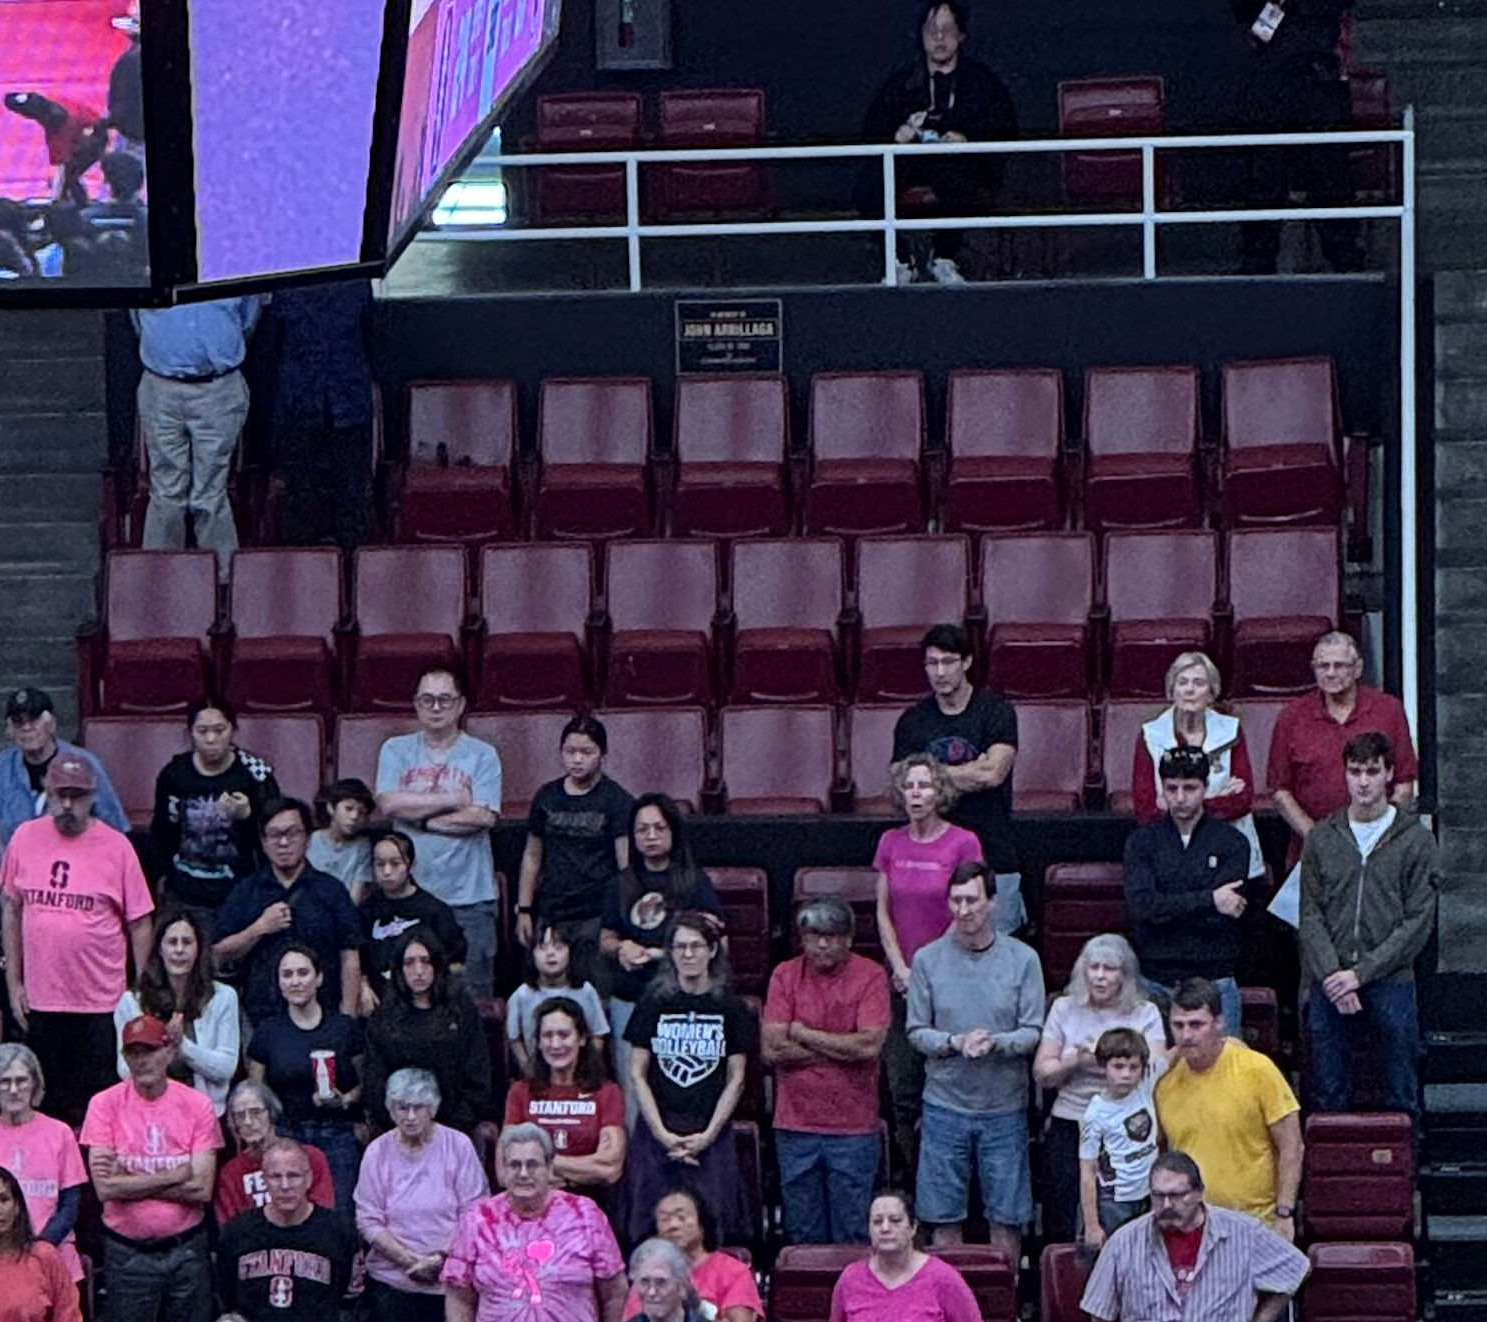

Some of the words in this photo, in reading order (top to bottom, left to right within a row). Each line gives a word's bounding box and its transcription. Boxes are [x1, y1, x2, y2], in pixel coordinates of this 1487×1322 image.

[684, 323, 711, 336] JOHN
[657, 1023, 724, 1040] WOMEN'S
[651, 1037, 726, 1058] VOLLEYBALL
[528, 1100, 597, 1115] STANFORD
[238, 1248, 331, 1285] STANFORD
